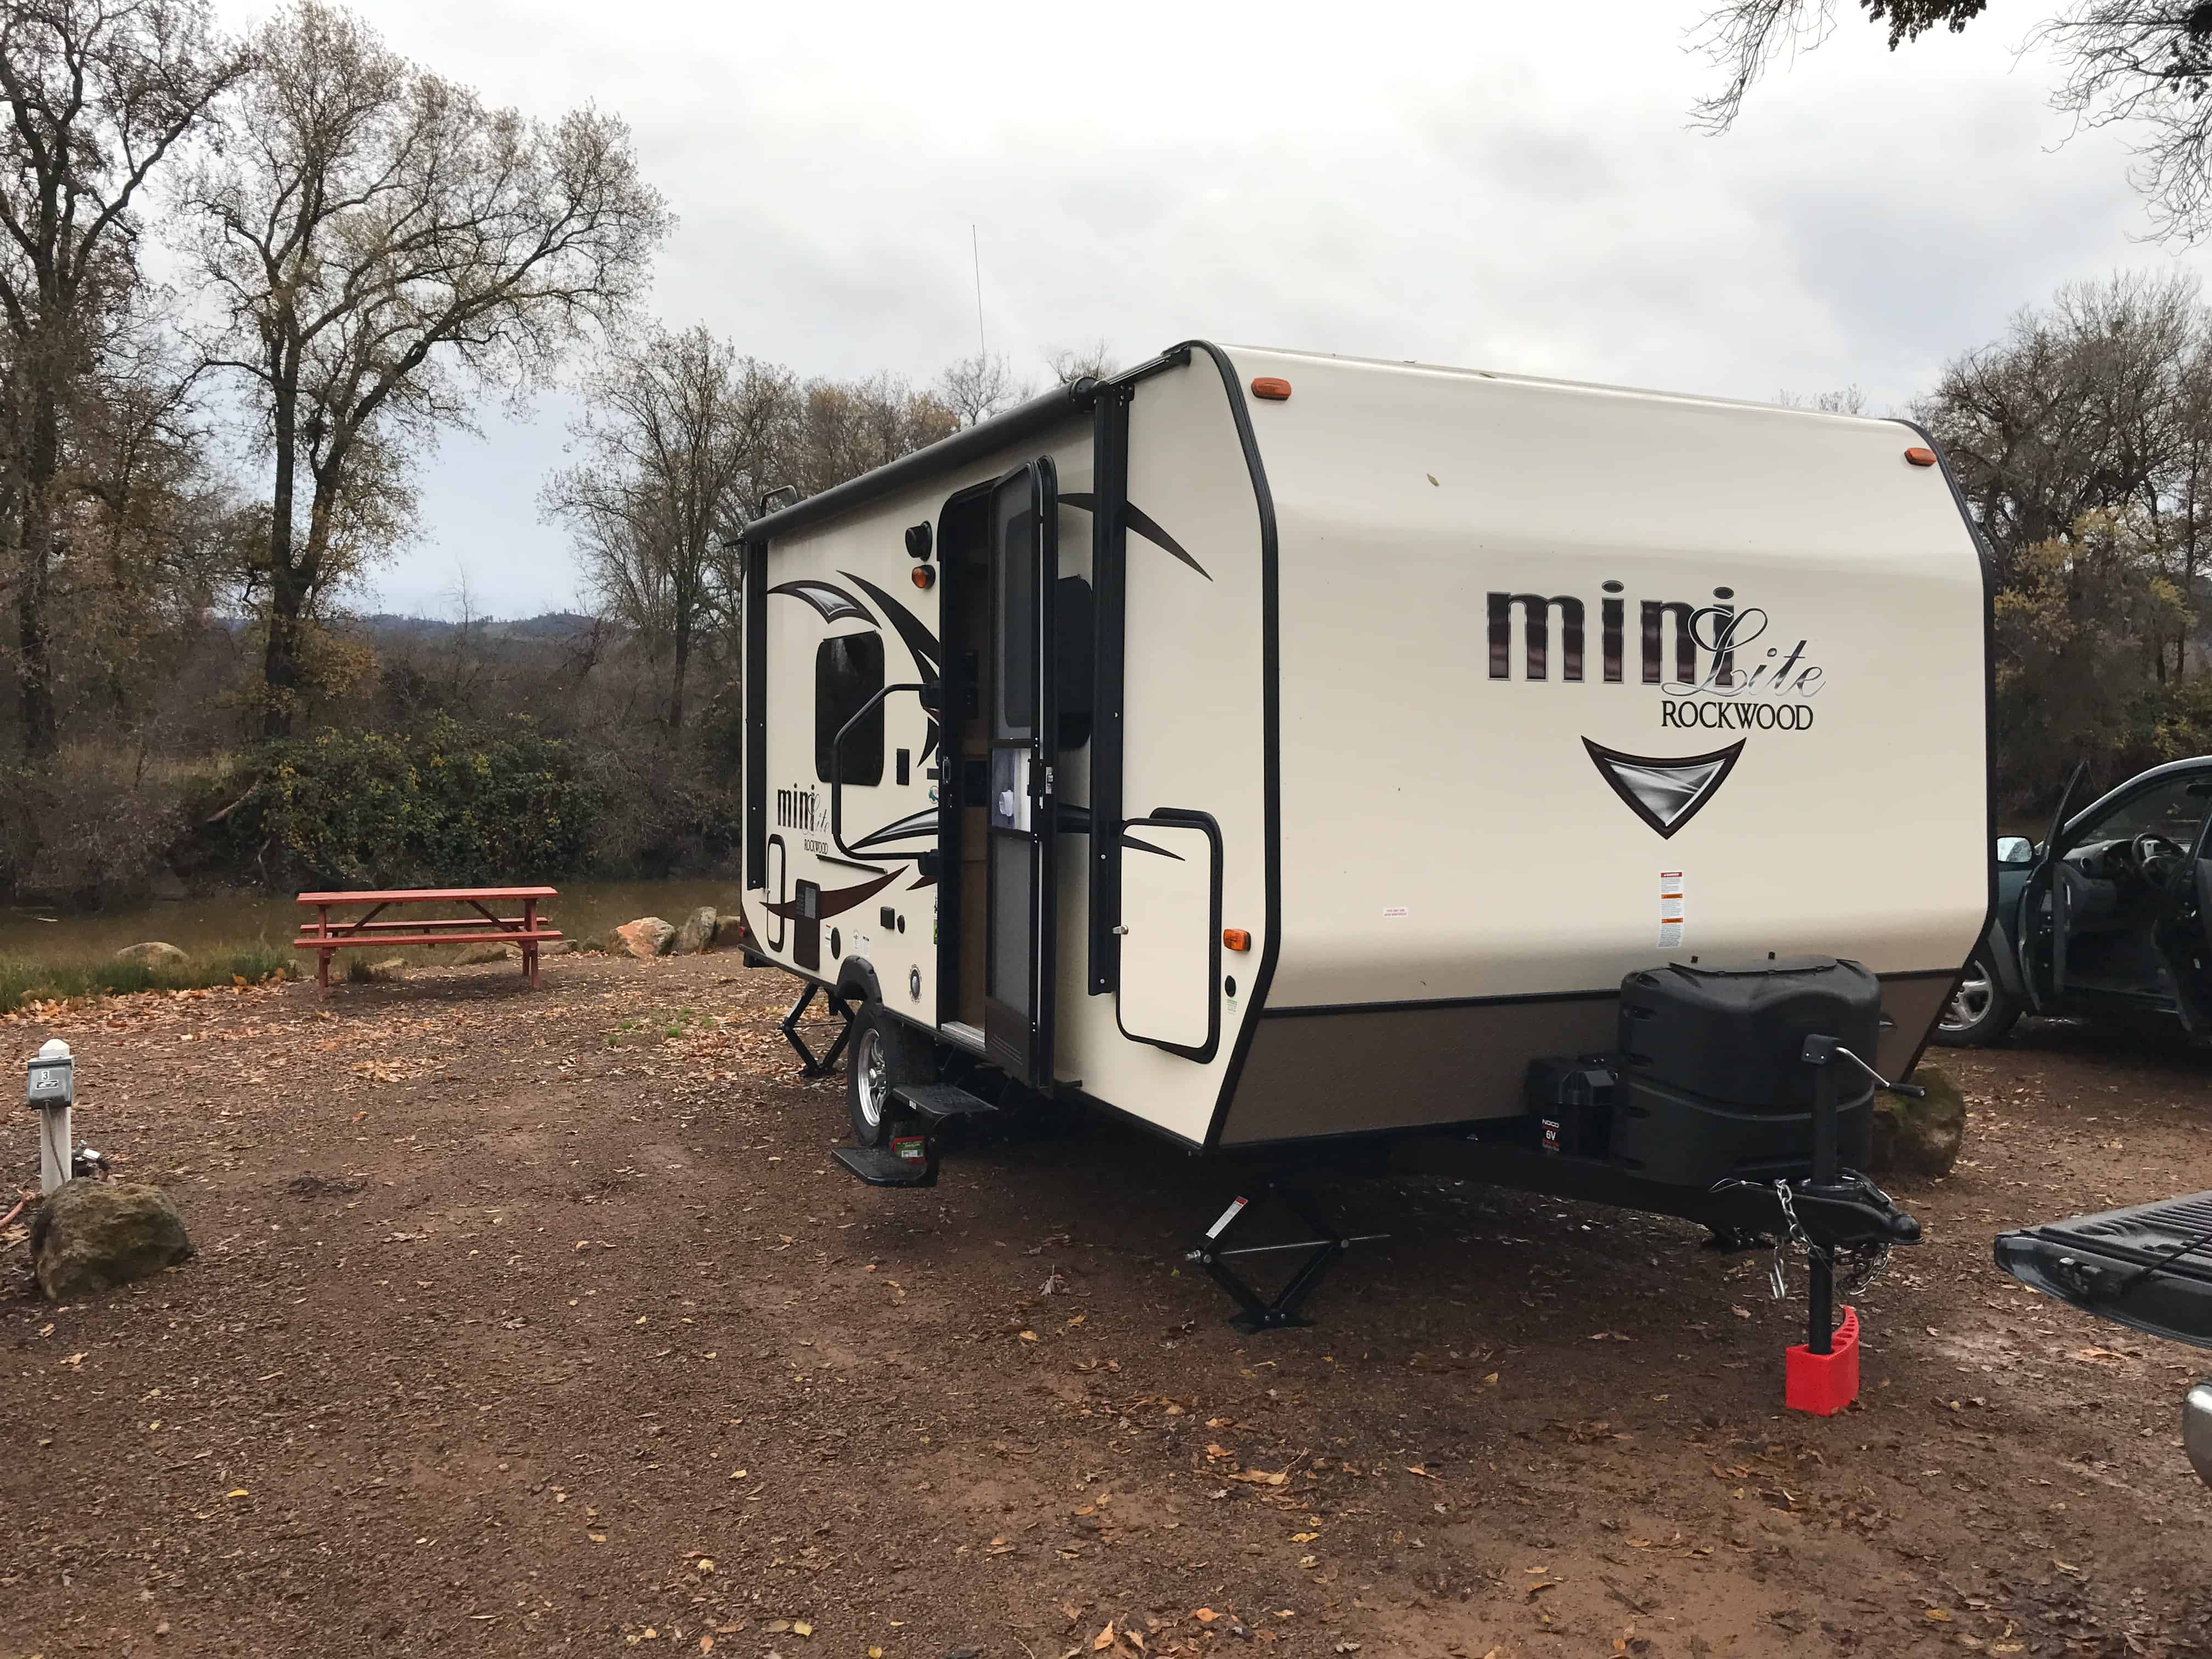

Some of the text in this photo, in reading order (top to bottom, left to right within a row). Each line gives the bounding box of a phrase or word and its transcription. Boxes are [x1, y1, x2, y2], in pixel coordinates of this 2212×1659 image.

[1487, 580, 1826, 697] mini Lite
[1661, 701, 1813, 730] ROCKWOOD
[777, 783, 815, 831] mini
[43, 1071, 48, 1080] 3
[1546, 1130, 1556, 1141] 6V
